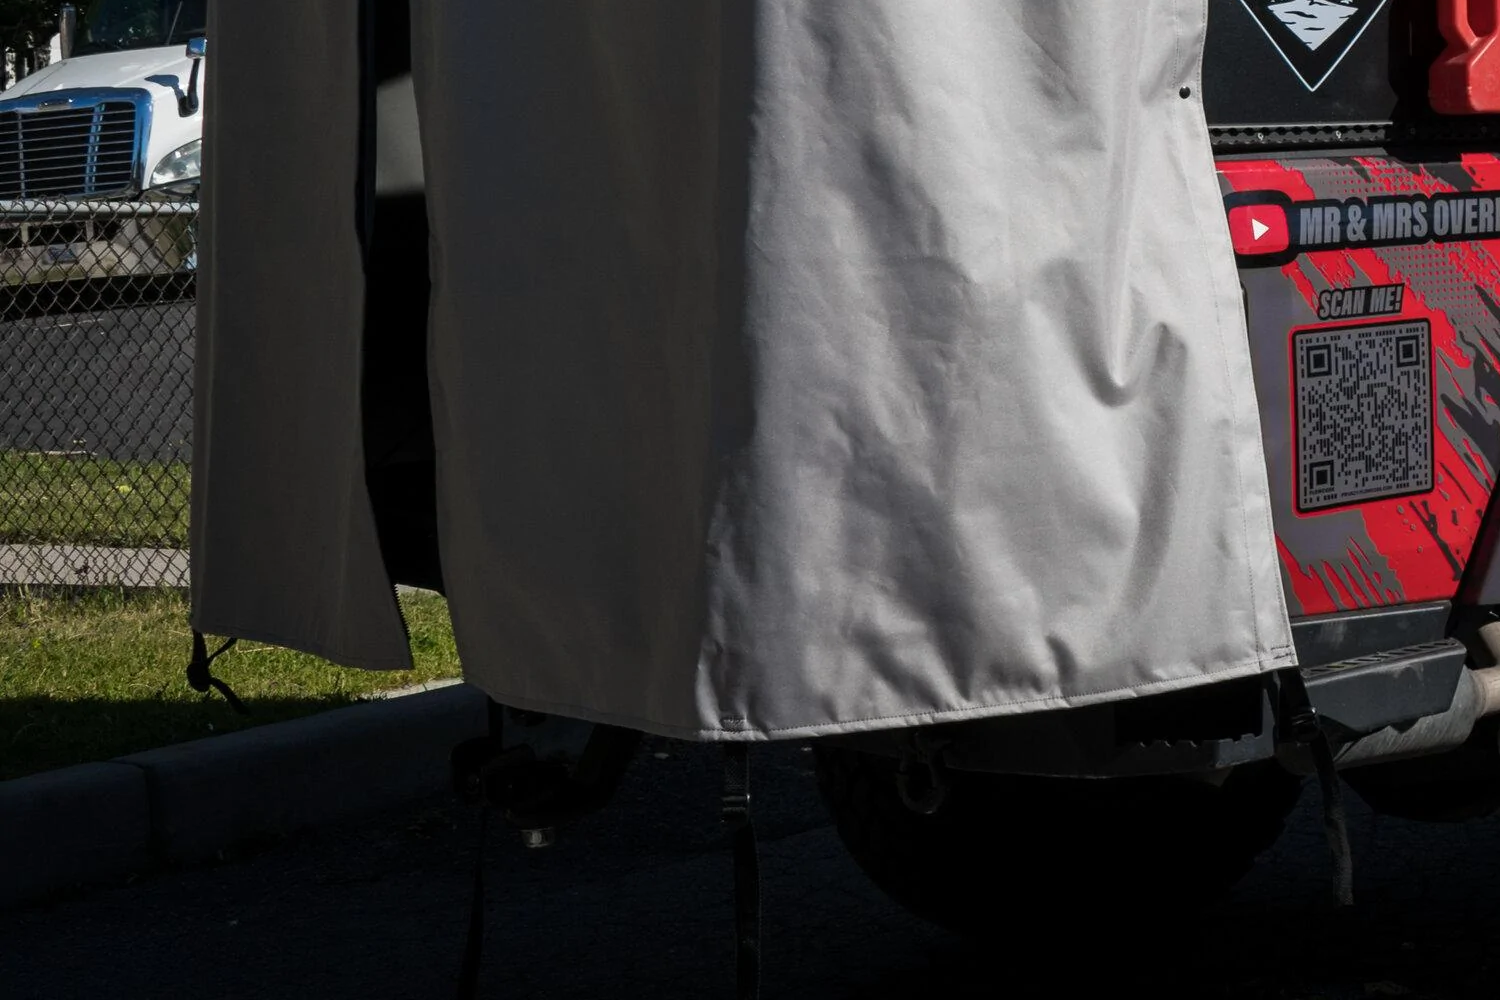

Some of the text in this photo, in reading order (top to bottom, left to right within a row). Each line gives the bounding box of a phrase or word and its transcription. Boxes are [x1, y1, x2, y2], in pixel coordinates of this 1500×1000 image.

[1300, 206, 1341, 245] MR
[1347, 204, 1367, 241] &
[1372, 201, 1427, 240] MRS
[1320, 286, 1402, 318] SCAN ME!
